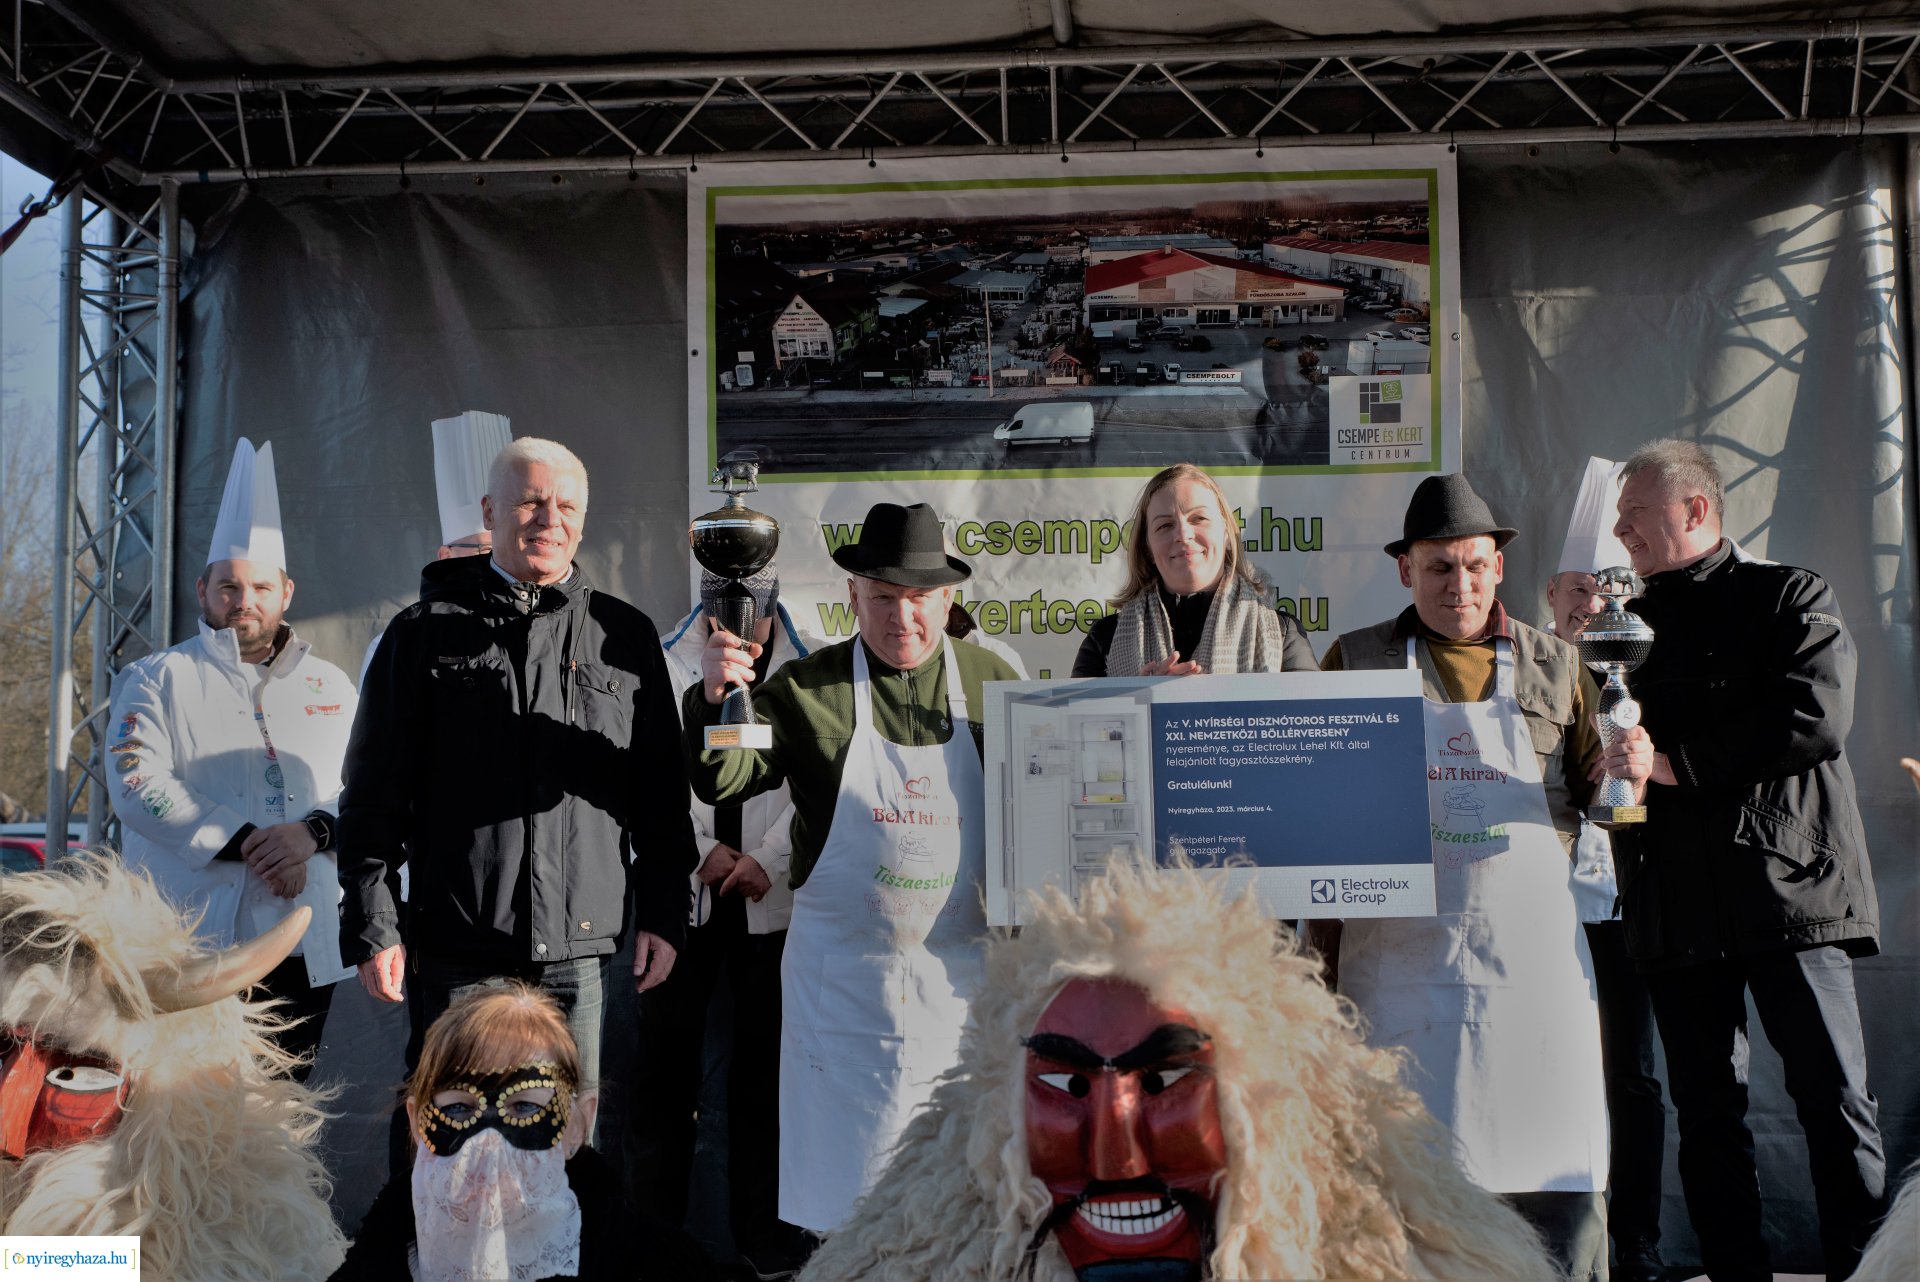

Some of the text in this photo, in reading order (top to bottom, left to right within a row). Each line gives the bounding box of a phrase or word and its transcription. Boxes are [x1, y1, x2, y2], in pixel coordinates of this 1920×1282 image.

[1338, 429, 1379, 443] CSEMPE
[1397, 426, 1424, 443] KERT
[1351, 448, 1411, 460] CENTRUM
[1165, 713, 1400, 729] Az V. NYÍRSÉGI DISZNÓTOROS FESZTIVÁL ÉS
[1166, 727, 1350, 741] XXI. NEMZETKÖZI BÖLLÉRVERSENY
[1166, 743, 1230, 755] nyereménye,
[1232, 743, 1246, 752] az
[1248, 742, 1298, 752] Electrolux
[1300, 741, 1328, 750] Lehel
[1347, 740, 1371, 750] által
[1166, 755, 1315, 768] felajánlott fagyasztószekrény.
[1167, 779, 1232, 791] Gratulálunk!
[1216, 805, 1236, 814] 2023.
[1237, 805, 1265, 813] március
[1218, 835, 1247, 844] Ferenc
[1340, 878, 1410, 891] Electrolux
[1341, 891, 1387, 906] Group
